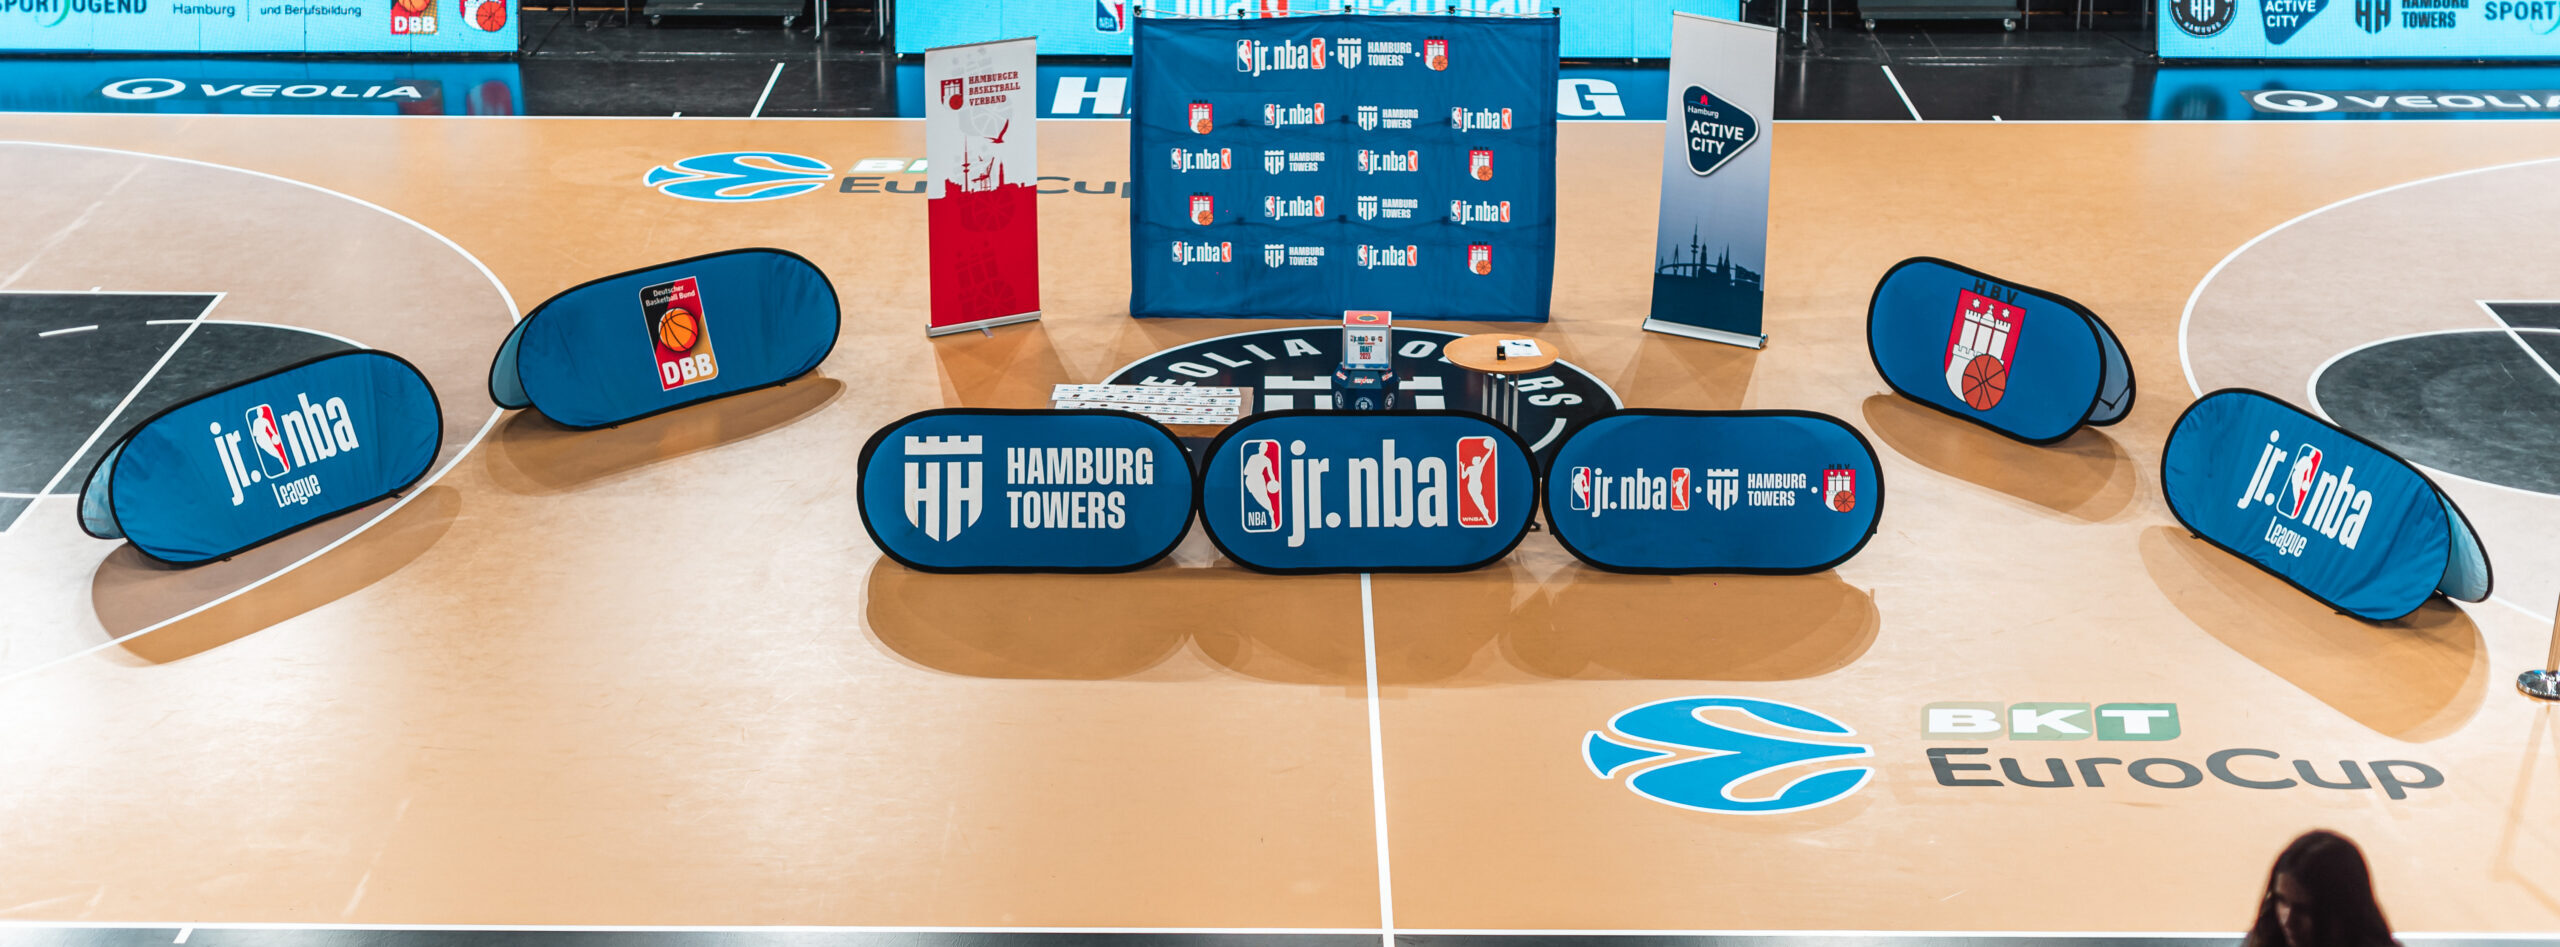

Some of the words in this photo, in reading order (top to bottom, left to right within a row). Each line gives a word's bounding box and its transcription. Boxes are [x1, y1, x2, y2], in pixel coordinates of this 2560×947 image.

[173, 3, 235, 17] Hamburg
[260, 5, 281, 15] und
[284, 4, 362, 17] Berufsbildung
[2265, 0, 2317, 12] ACTIVE
[394, 16, 435, 33] DBB
[2267, 15, 2299, 28] CITY
[2401, 11, 2456, 28] TOWERS
[1367, 42, 1412, 54] HAMBURG
[1367, 54, 1404, 66] TOWERS
[969, 71, 1018, 84] HAMBURGER
[200, 83, 423, 98] VEOLIA
[969, 82, 1021, 95] BASKETBALL
[969, 94, 1007, 106] VERBAND
[1382, 109, 1418, 119] HAMBURG
[1687, 105, 1719, 119] Hamburg
[1382, 119, 1412, 129] TOWERS
[1690, 120, 1744, 141] ACTIVE
[1691, 137, 1725, 155] CITY
[1289, 152, 1325, 162] HAMBURG
[1289, 162, 1318, 172] TOWERS
[1382, 199, 1418, 209] HAMBURG
[1382, 209, 1411, 218] TOWERS
[1289, 247, 1325, 256] HAMBURG
[1289, 257, 1318, 266] TOWERS
[645, 294, 679, 307] Basketball
[679, 289, 696, 300] Bund
[653, 285, 684, 297] Deutscher
[1973, 279, 2018, 305] HBV
[662, 353, 714, 385] DBB
[281, 392, 360, 468] nba
[1006, 447, 1154, 486] HAMBURG
[1748, 473, 1806, 490] HAMBURG
[271, 474, 321, 509] League
[1748, 490, 1795, 507] TOWERS
[1006, 490, 1127, 530] TOWERS
[2302, 465, 2373, 550] nba
[1248, 511, 1267, 527] NBA
[2264, 515, 2308, 558] League
[1928, 708, 2170, 735] BKT
[1926, 747, 2446, 801] EuroCup
